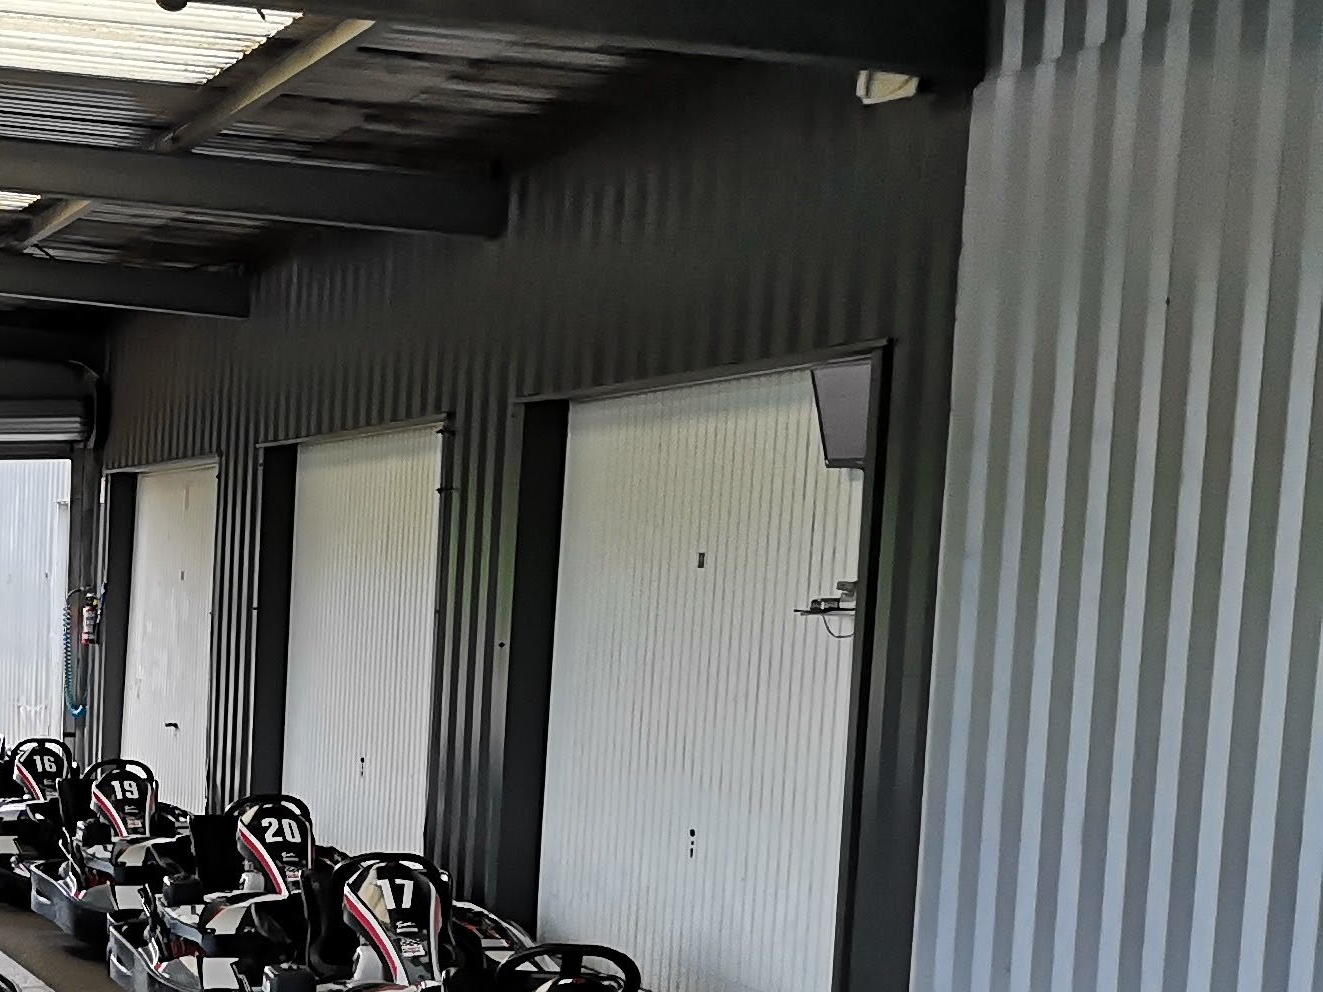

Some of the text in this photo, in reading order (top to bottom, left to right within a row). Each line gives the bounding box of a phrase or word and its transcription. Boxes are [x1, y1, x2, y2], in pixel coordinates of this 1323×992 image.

[33, 755, 57, 773] 16
[110, 780, 139, 799] 19
[261, 817, 301, 843] 20
[377, 878, 414, 910] 17
